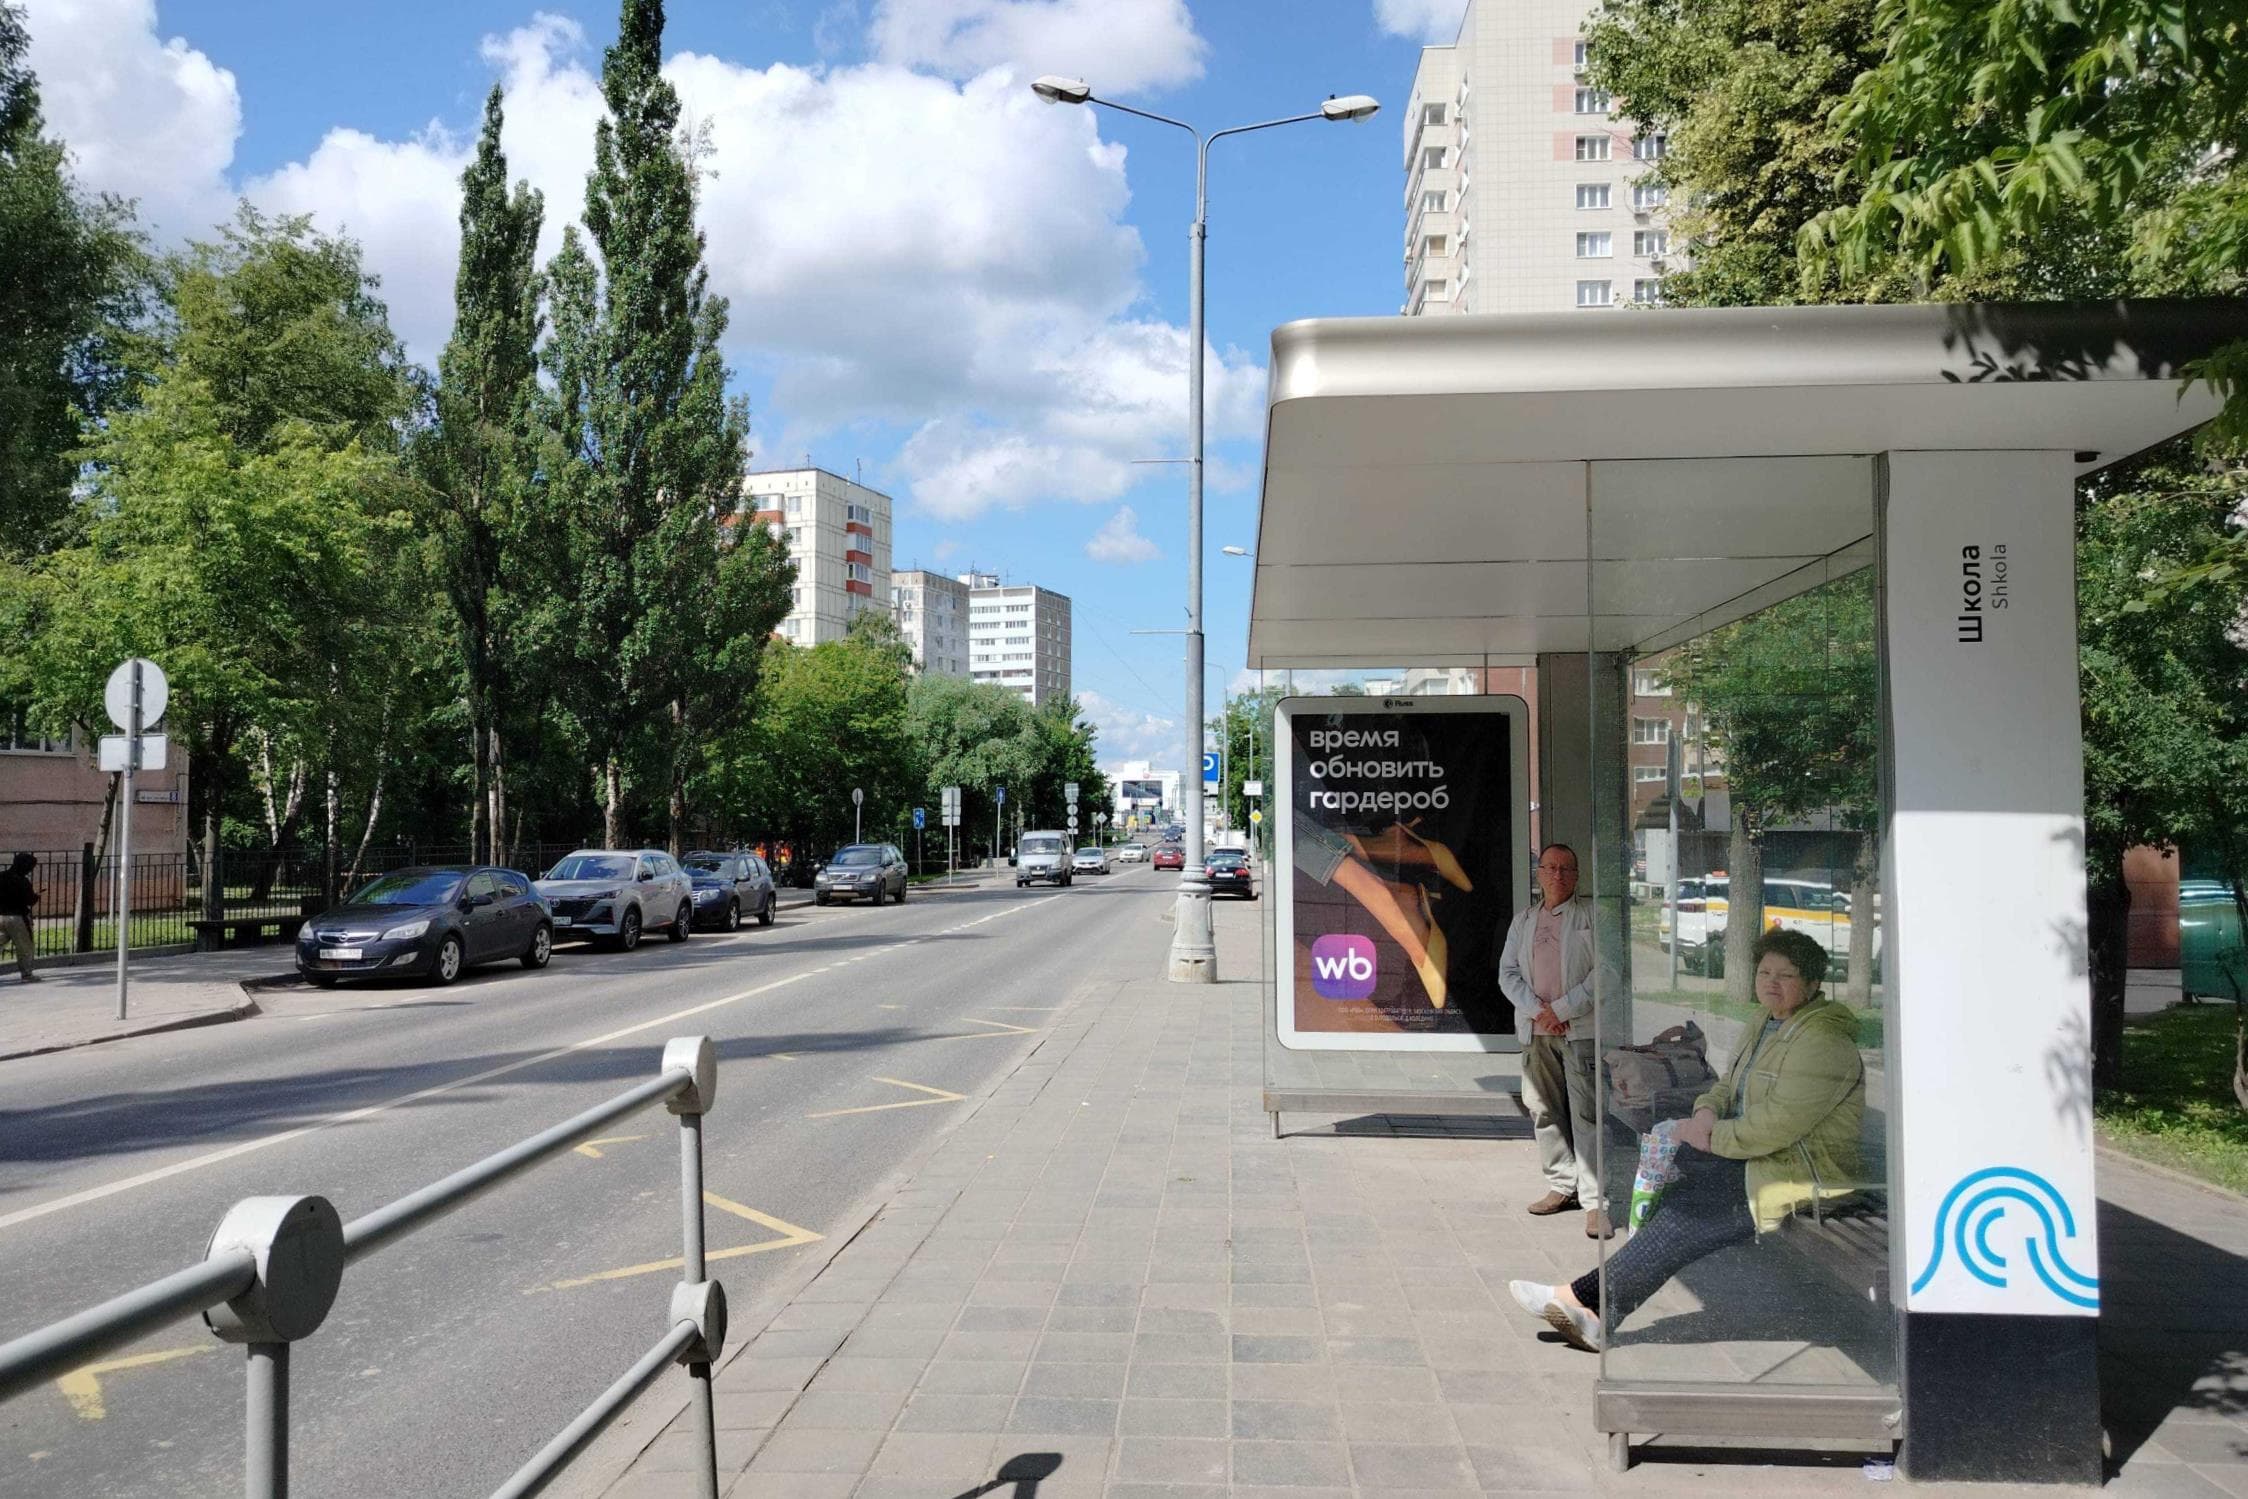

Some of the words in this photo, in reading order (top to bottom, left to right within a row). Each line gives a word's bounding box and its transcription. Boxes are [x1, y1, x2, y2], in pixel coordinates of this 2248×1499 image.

[1989, 543, 2009, 609] Shkola
[1958, 544, 1983, 643] Школа
[1309, 730, 1400, 754] время
[1309, 754, 1445, 779] обновить
[1309, 784, 1450, 815] гардероб
[1315, 947, 1373, 981] wb
